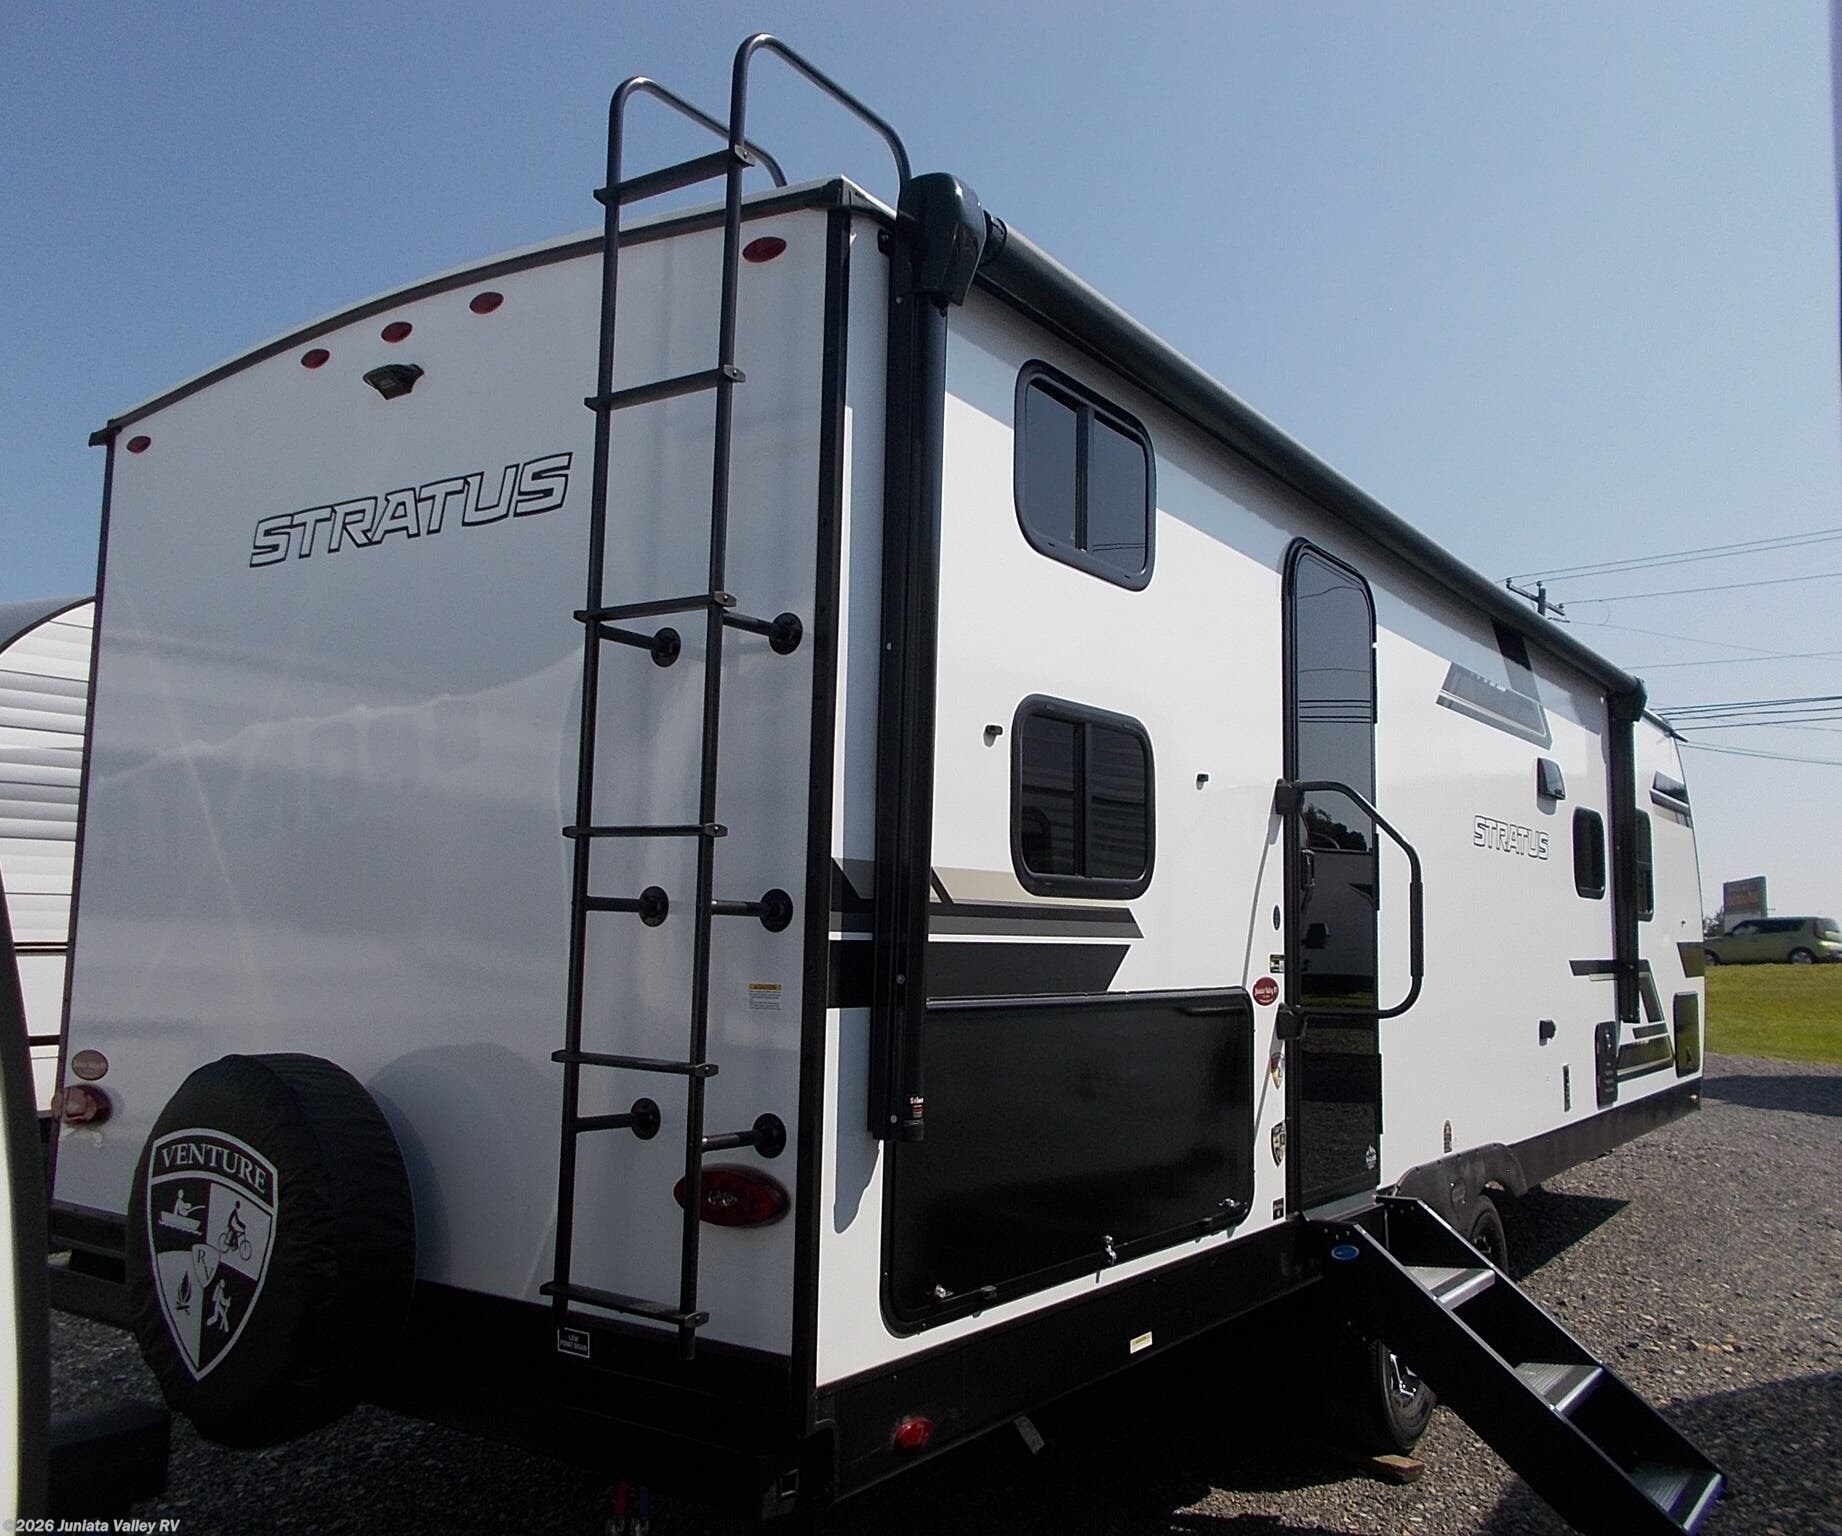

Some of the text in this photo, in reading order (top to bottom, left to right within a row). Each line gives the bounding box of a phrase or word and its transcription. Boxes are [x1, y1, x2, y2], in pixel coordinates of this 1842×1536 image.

[250, 452, 573, 567] STRATUS
[1474, 815, 1549, 860] STRATUS
[161, 1143, 266, 1194] VENTURE
